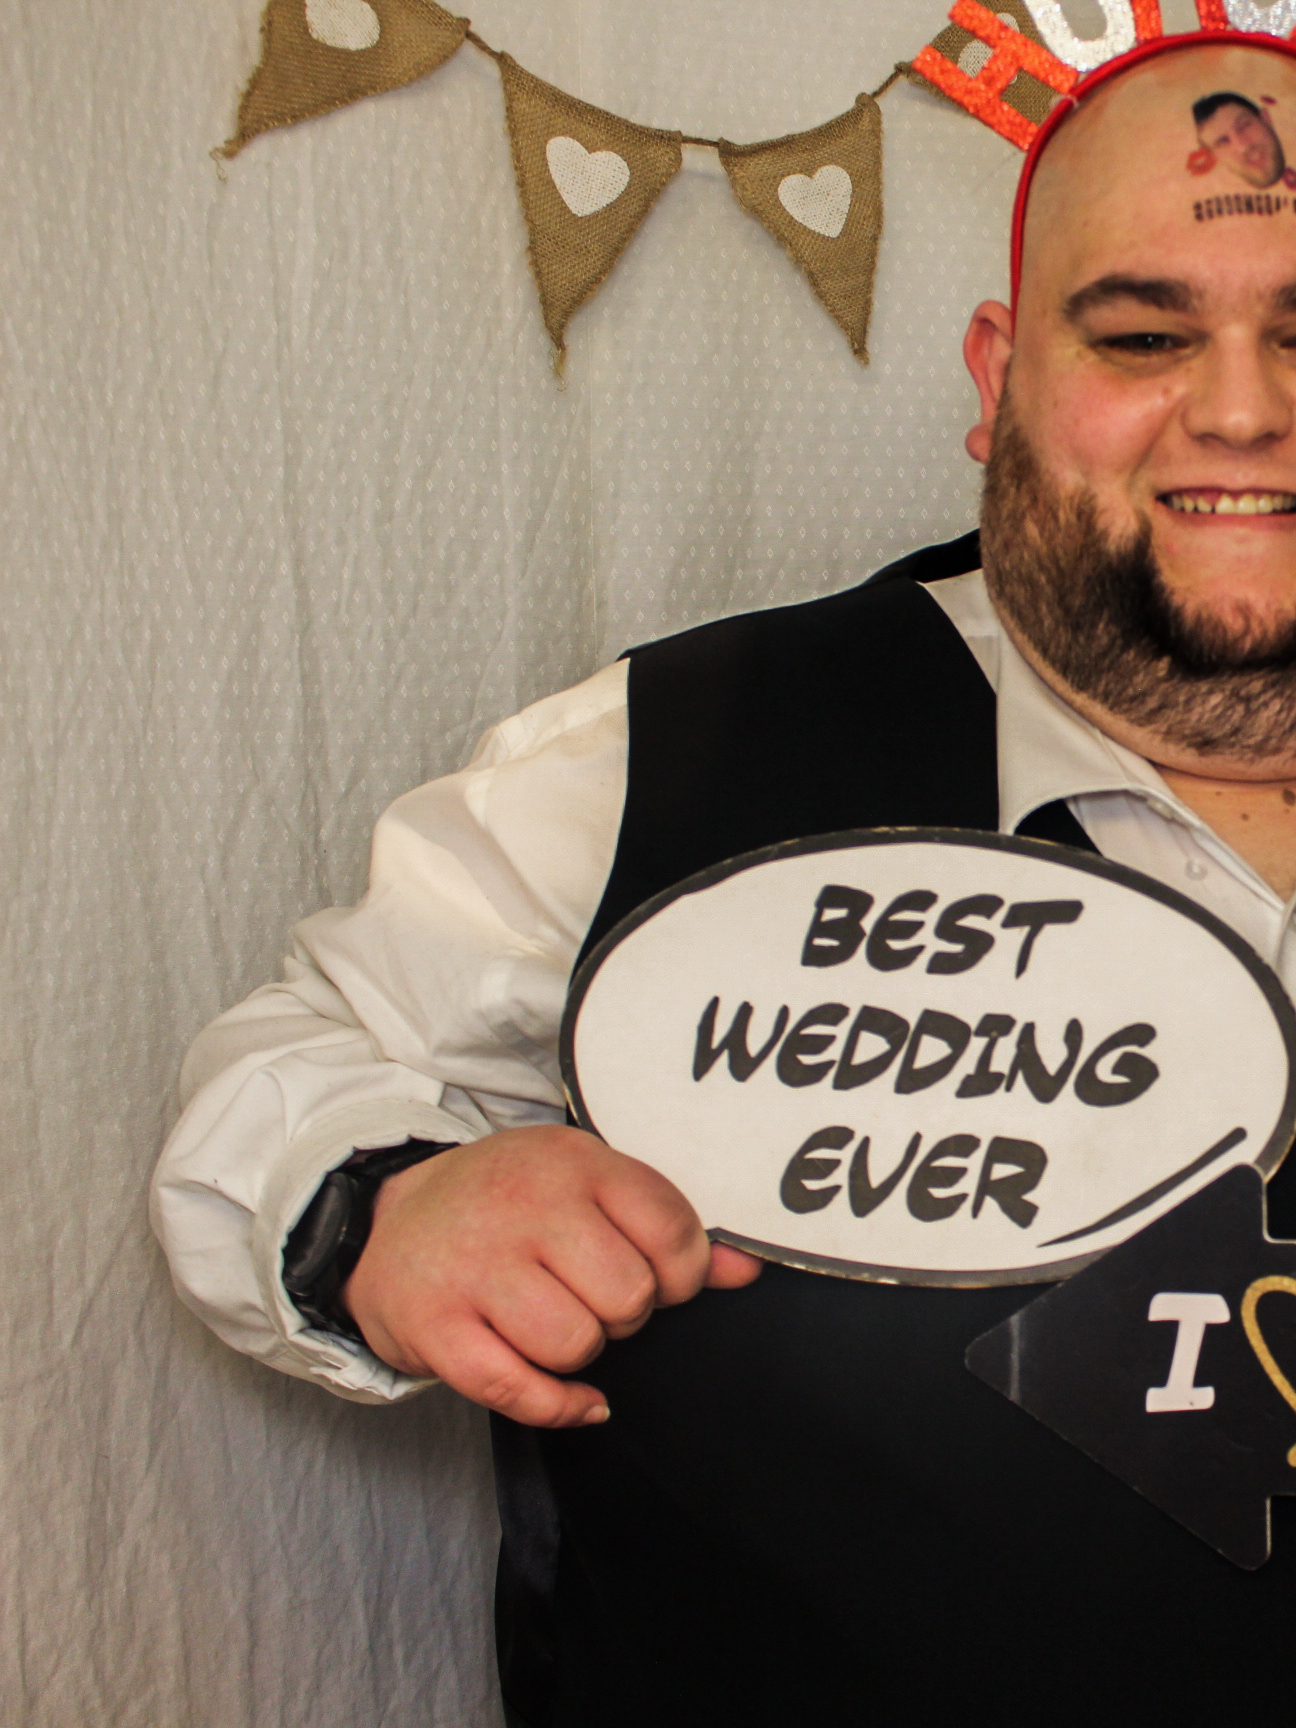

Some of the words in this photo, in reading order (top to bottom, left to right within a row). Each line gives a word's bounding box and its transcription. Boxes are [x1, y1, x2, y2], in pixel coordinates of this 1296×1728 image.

[800, 884, 1084, 979] BEST
[692, 996, 1160, 1107] WEDDING
[779, 1125, 1048, 1229] EVER
[1145, 1292, 1231, 1413] I
